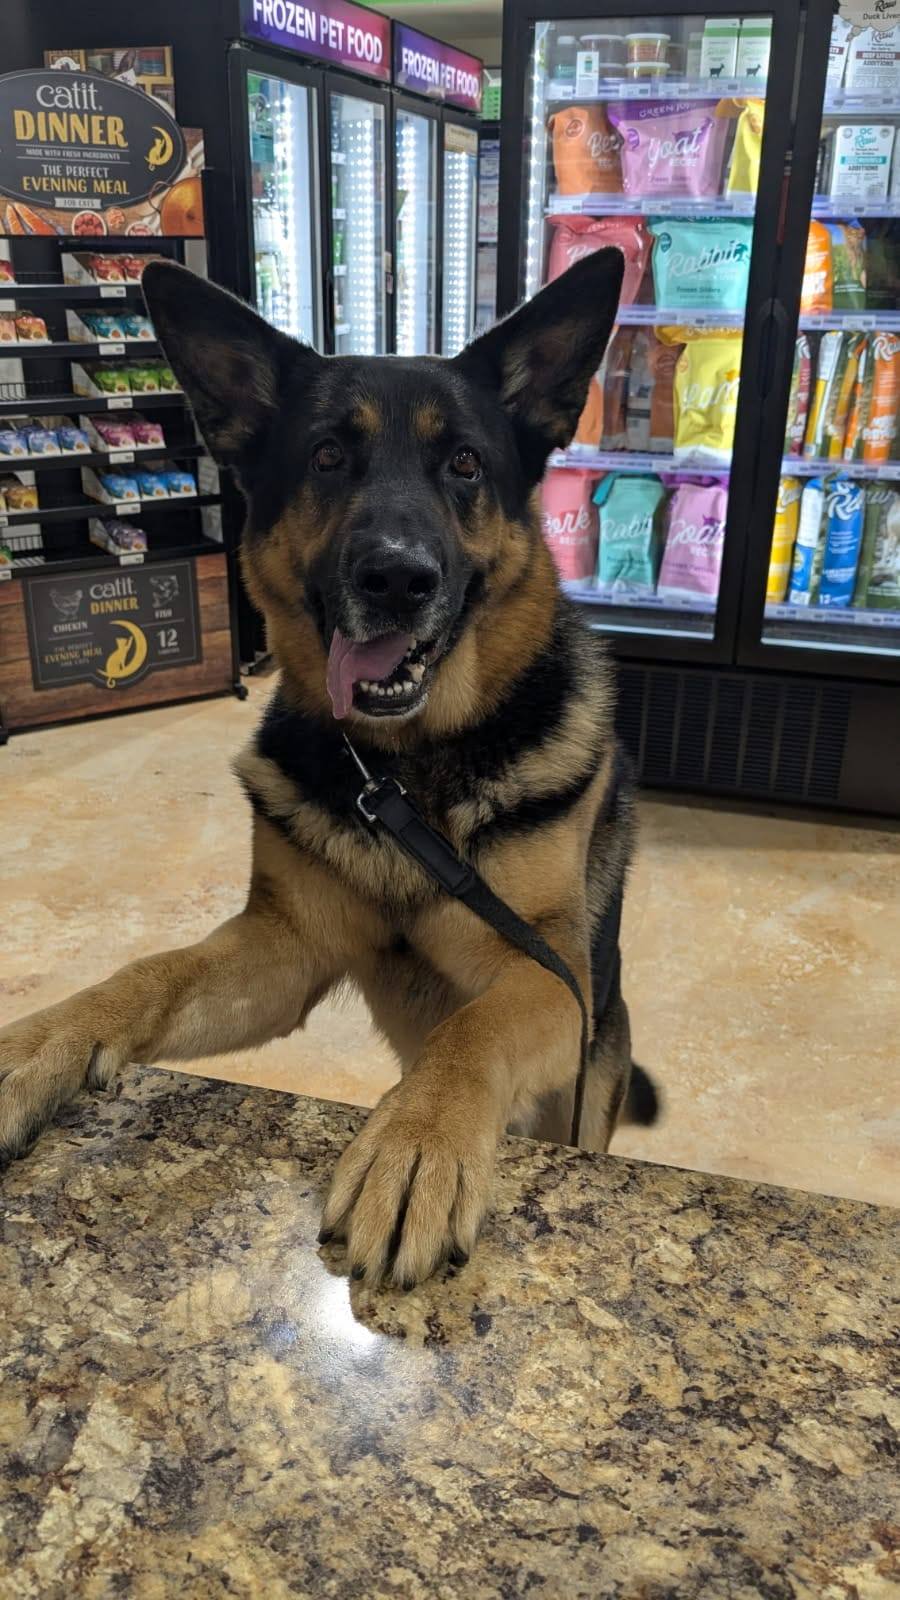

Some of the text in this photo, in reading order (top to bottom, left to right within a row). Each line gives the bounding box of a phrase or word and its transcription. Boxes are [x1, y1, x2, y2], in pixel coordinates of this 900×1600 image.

[252, 0, 382, 64] FROZEN PET FOOD
[402, 48, 480, 98] FROZEN PET FOOD
[14, 109, 129, 147] DINNER
[44, 149, 61, 157] WITH
[62, 150, 81, 158] FRESH
[41, 164, 109, 178] THE PERFECT
[22, 175, 130, 195] EVENING MEAL
[545, 506, 591, 536] ork
[90, 597, 139, 615] DINNER
[53, 622, 88, 633] CHICKEN
[156, 628, 178, 648] 12
